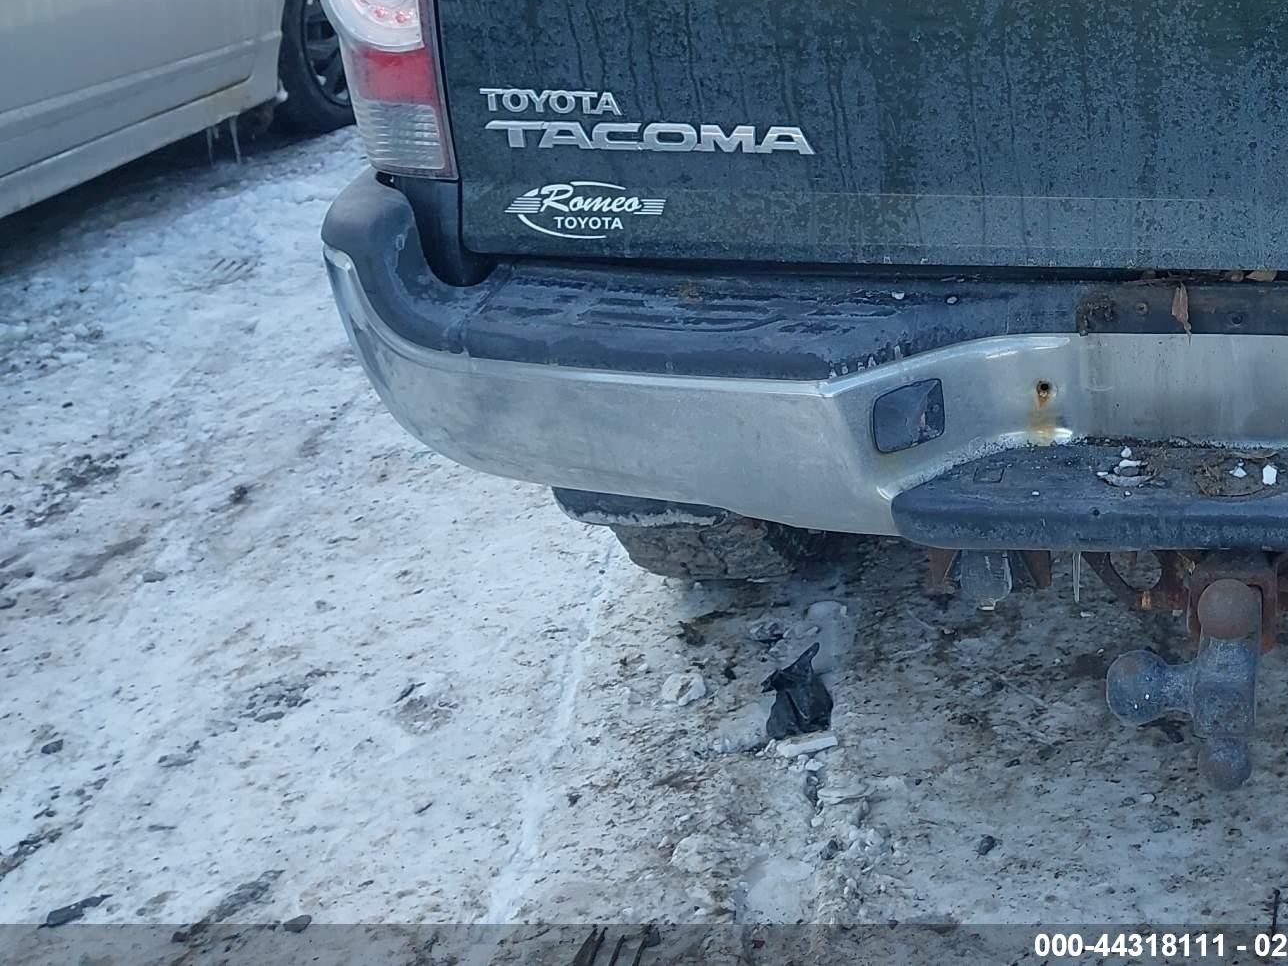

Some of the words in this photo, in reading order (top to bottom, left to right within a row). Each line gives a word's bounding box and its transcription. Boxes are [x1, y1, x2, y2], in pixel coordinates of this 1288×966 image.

[479, 88, 623, 116] TOYOTA
[484, 120, 816, 155] TACOMA
[540, 184, 643, 213] Romeo
[553, 216, 624, 230] TOYOTA
